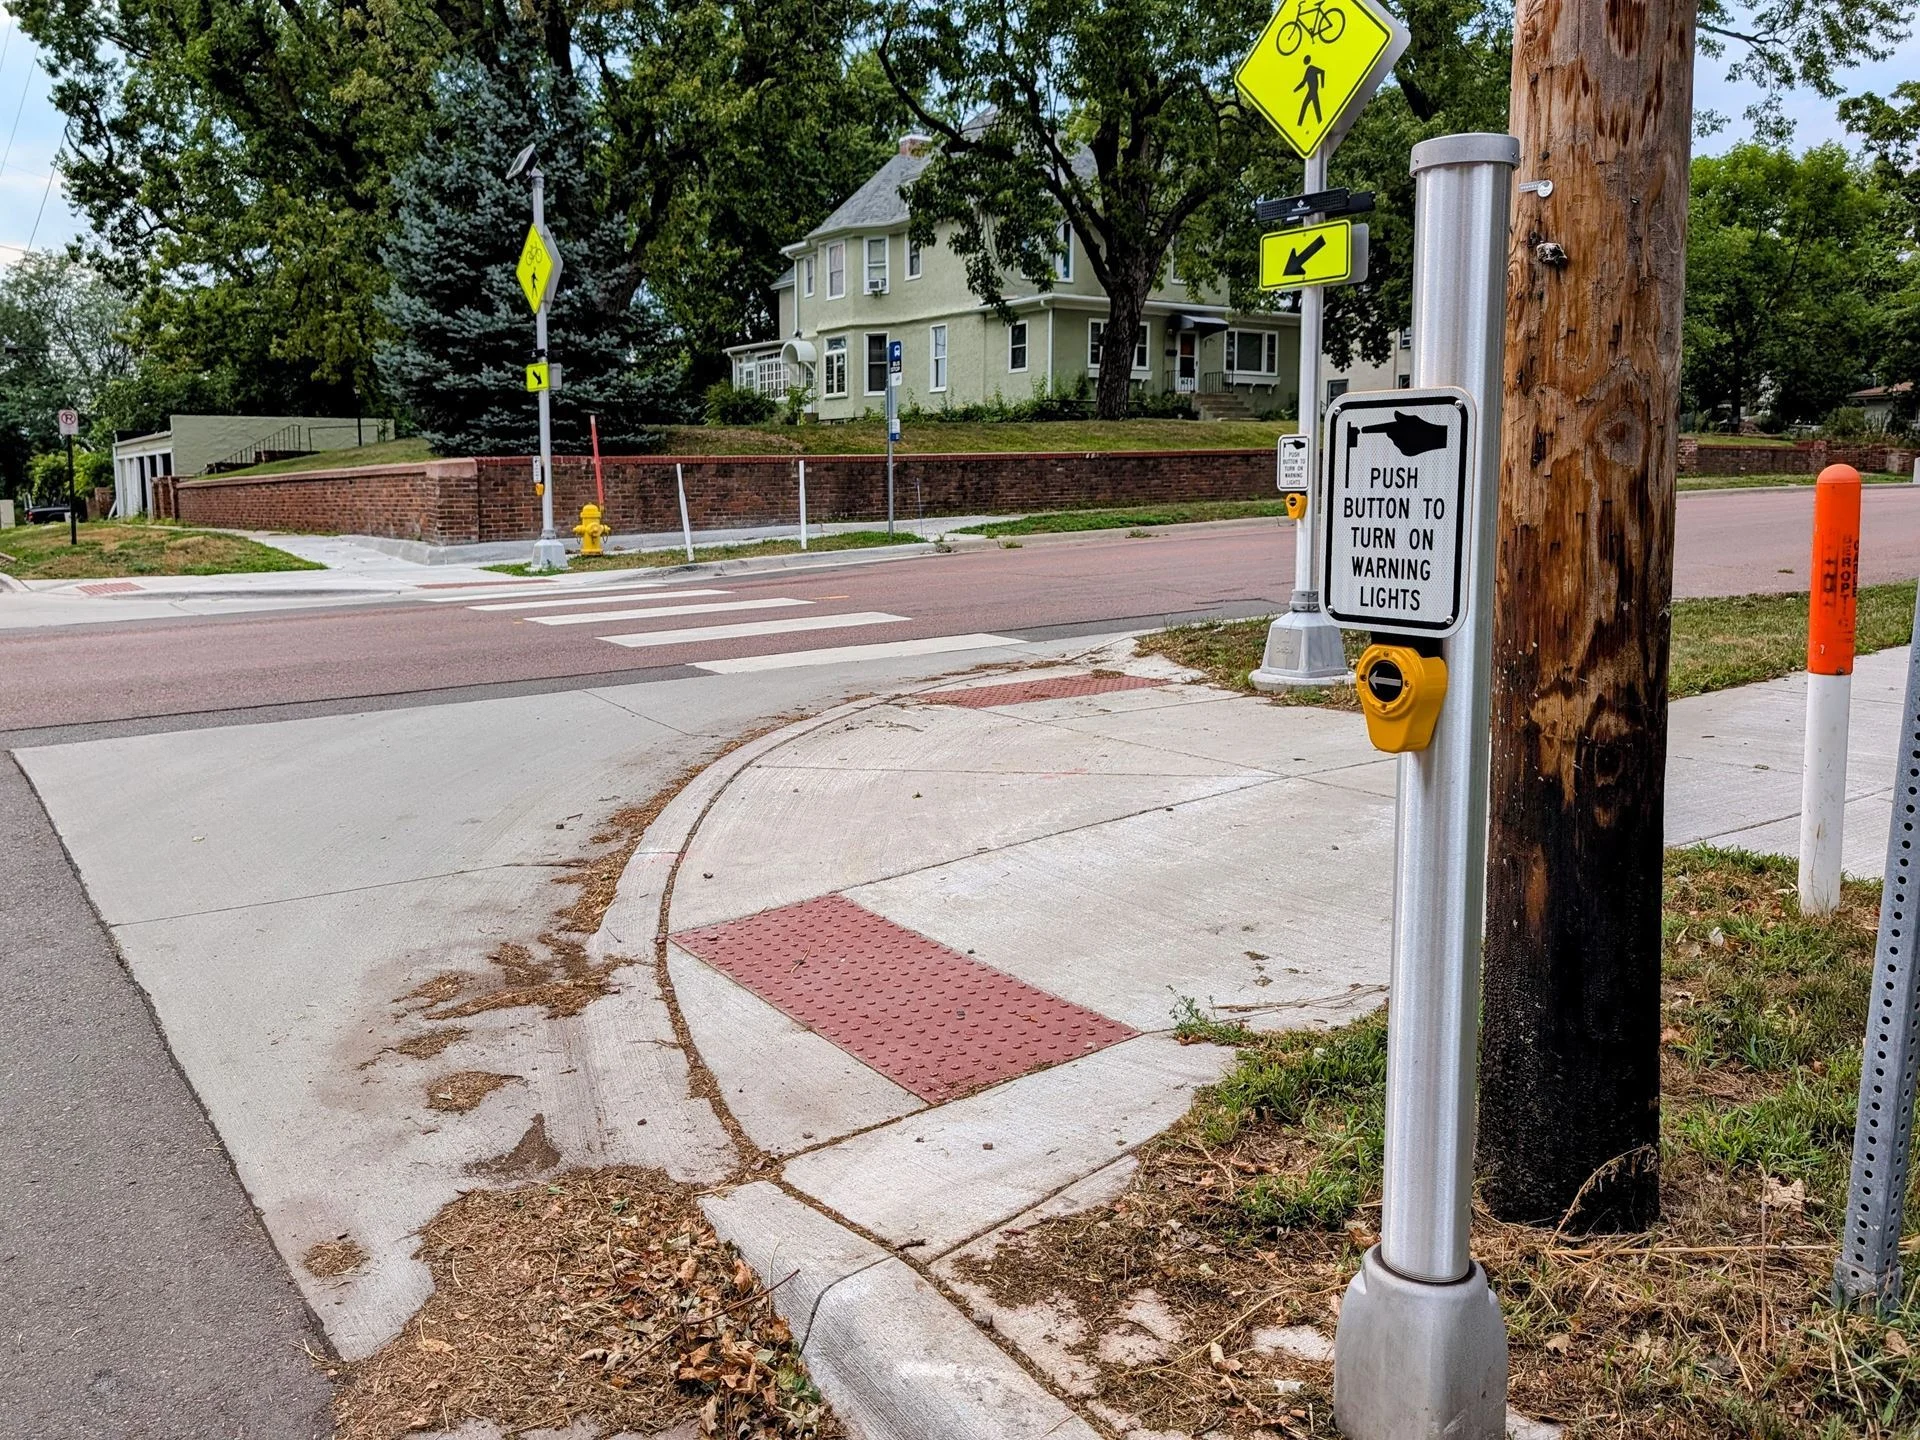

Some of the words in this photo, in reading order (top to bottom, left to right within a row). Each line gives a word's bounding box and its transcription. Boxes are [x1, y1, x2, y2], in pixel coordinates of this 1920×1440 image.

[1370, 467, 1418, 489] PUSH
[1343, 497, 1409, 519] BUTTON
[1423, 498, 1445, 520] TO
[1351, 527, 1396, 549] TURN
[1409, 528, 1434, 551] ON
[1352, 556, 1431, 581] WARNING
[1360, 586, 1421, 611] LIGHTS
